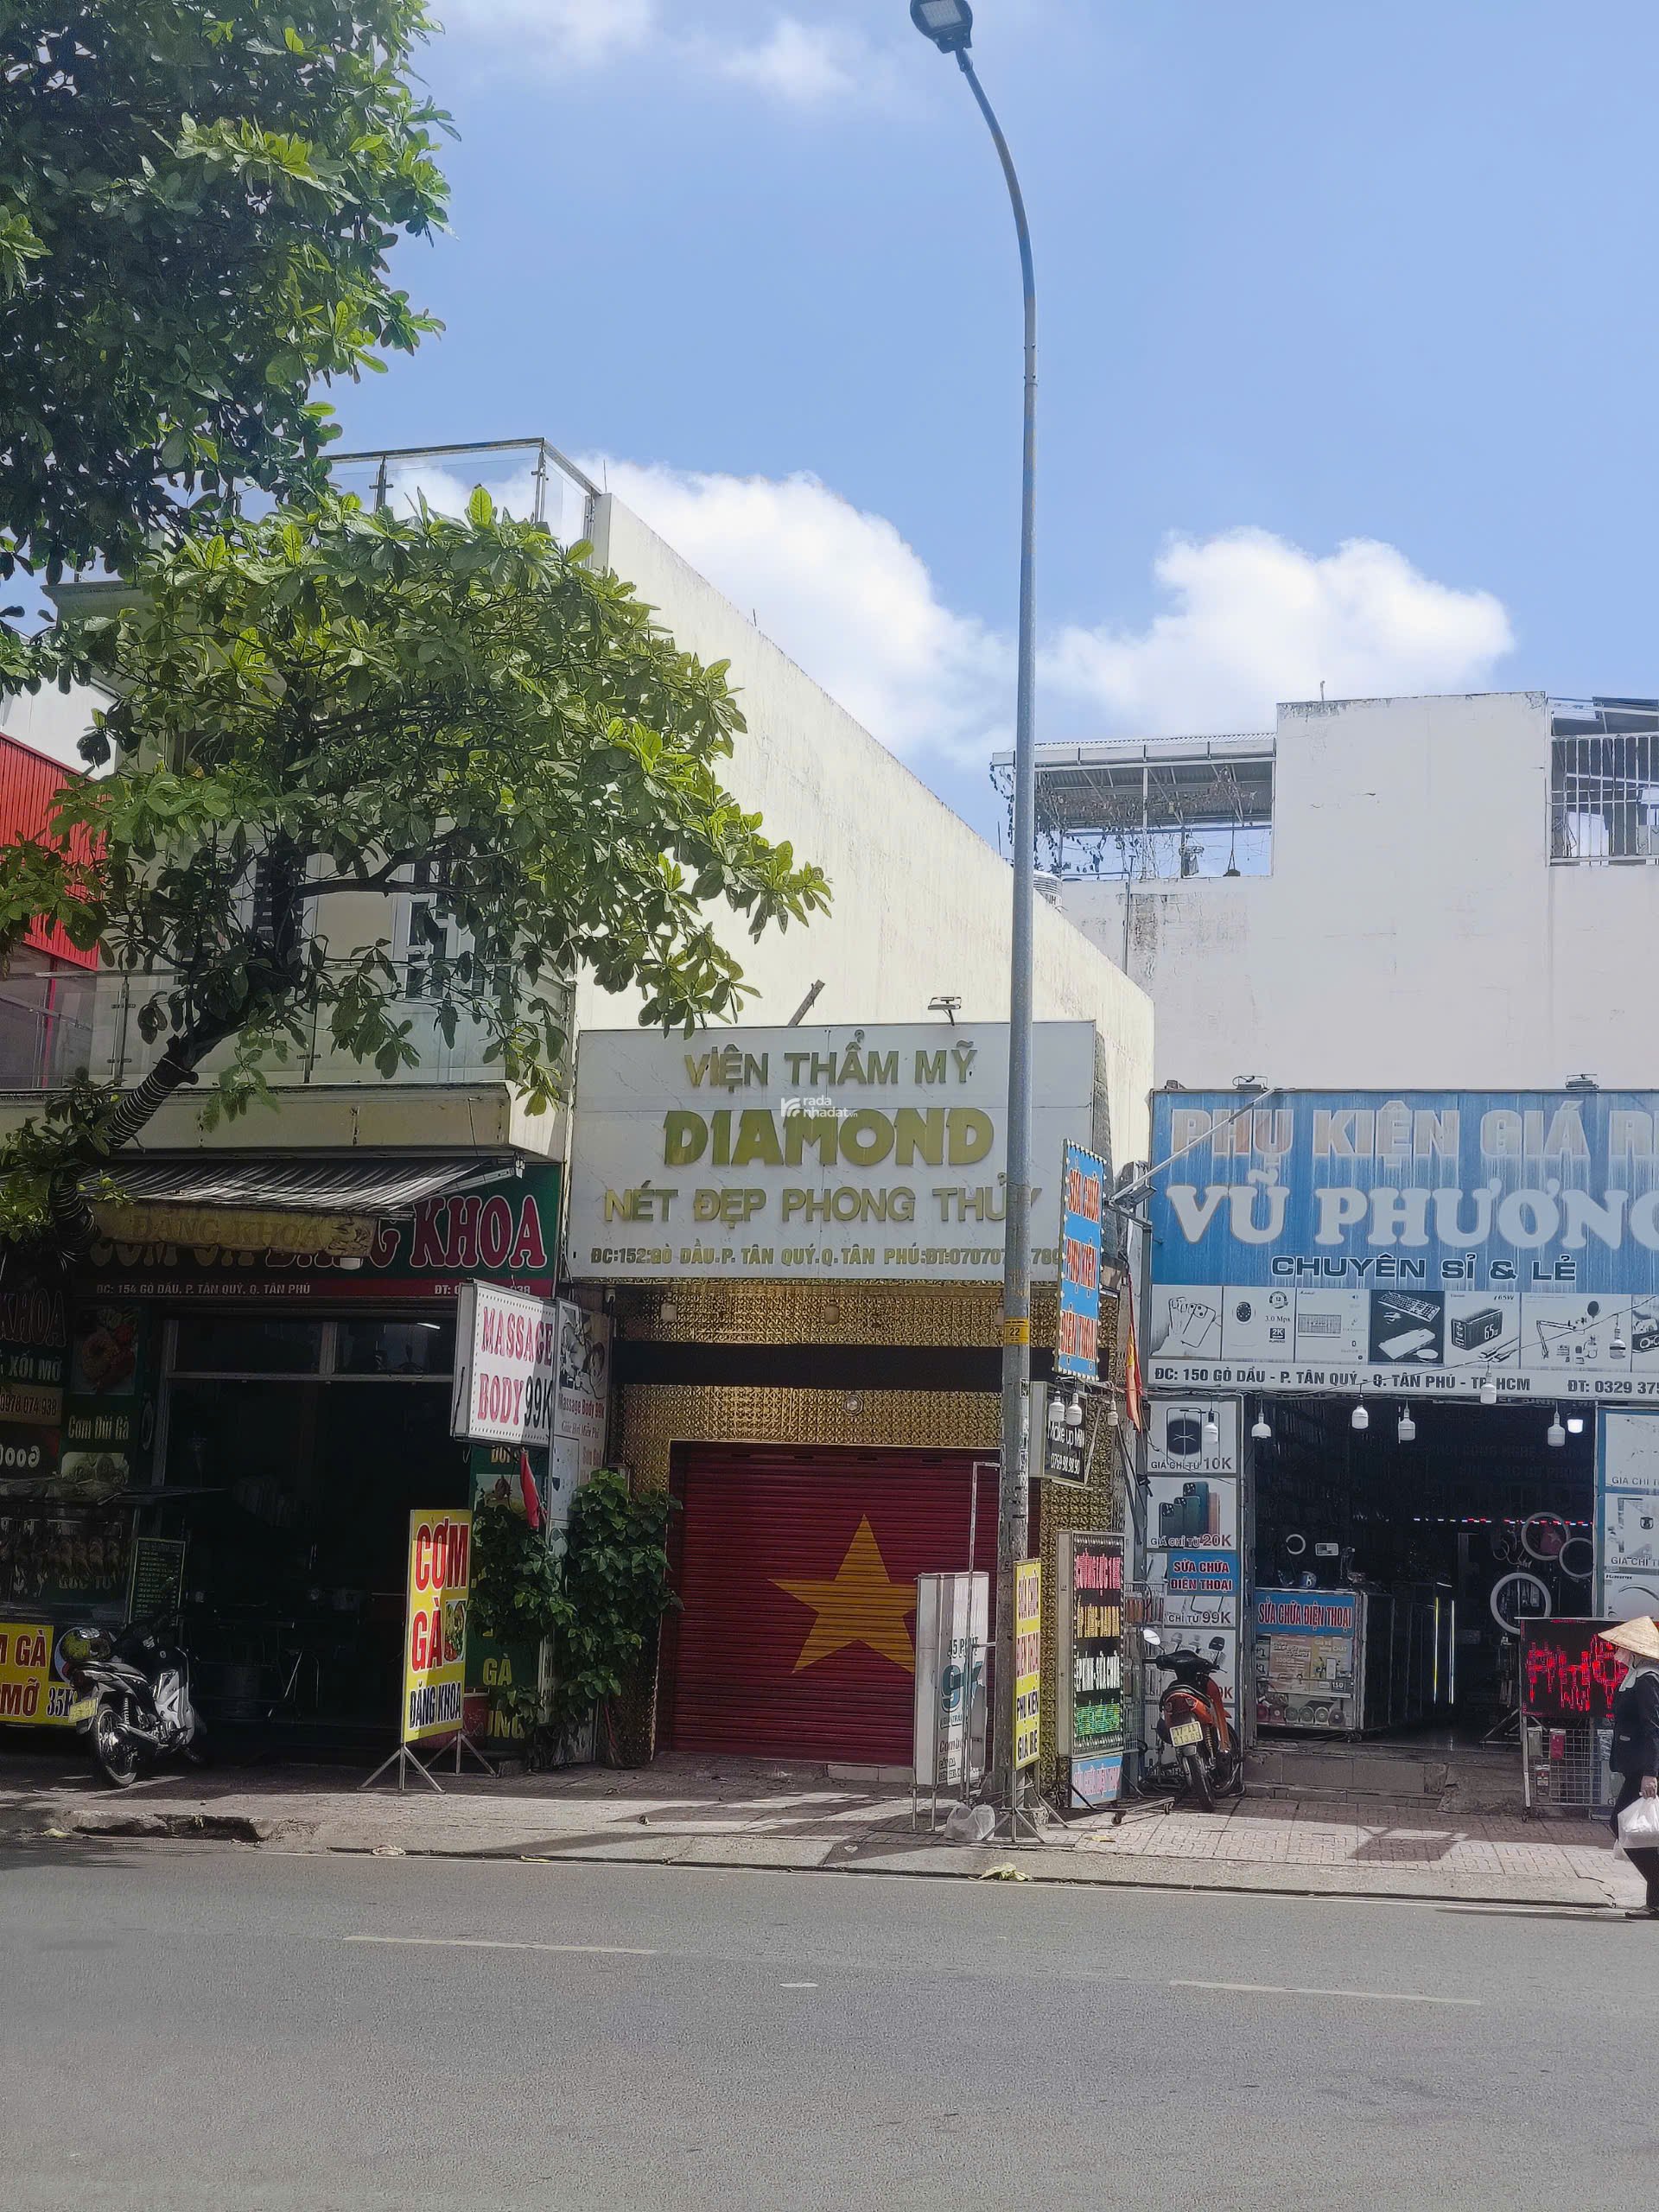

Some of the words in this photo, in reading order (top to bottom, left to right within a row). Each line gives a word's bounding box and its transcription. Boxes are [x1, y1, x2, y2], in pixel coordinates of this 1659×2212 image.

[684, 1044, 768, 1093] VIỆN
[784, 1029, 898, 1085] THẨM
[914, 1040, 977, 1084] MỸ
[664, 1108, 994, 1166] DIAMOND
[1171, 1109, 1294, 1169] PHỤ
[1313, 1100, 1459, 1168] KIỆN
[1480, 1100, 1590, 1159] GIÁ
[1609, 1109, 1659, 1158] R
[604, 1180, 679, 1222] NÉT
[693, 1188, 766, 1229] ĐẸP
[782, 1186, 916, 1222] PHONG
[932, 1172, 1042, 1222] THỦ
[1166, 1168, 1290, 1245] VŨ
[410, 1194, 547, 1269] KHOA
[741, 1244, 774, 1265] TÂN
[841, 1243, 874, 1265] TÂN
[1271, 1254, 1427, 1280] CHUYÊN
[1441, 1253, 1476, 1281] SỈ
[1490, 1260, 1517, 1281] &
[1531, 1255, 1577, 1281] LẺ
[288, 1282, 311, 1294] PHÚ
[480, 1306, 553, 1367] MASSAGE
[1154, 1368, 1178, 1380] ĐC:
[1183, 1369, 1208, 1381] 150
[1213, 1367, 1231, 1382] GÒ
[1280, 1371, 1291, 1383] P.
[1296, 1370, 1325, 1384] TÂN
[1330, 1370, 1357, 1385] QUÝ
[1372, 1374, 1387, 1387] Q.
[1392, 1372, 1421, 1388] TÂN
[1426, 1373, 1455, 1389] PHÚ
[1497, 1378, 1530, 1390] HCM
[1567, 1380, 1590, 1392] ĐT:
[1594, 1381, 1632, 1393] 0329
[1637, 1382, 1659, 1394] 37
[477, 1373, 524, 1426] BODY
[524, 1375, 553, 1430] 99K
[1204, 1458, 1231, 1470] 10K
[415, 1516, 469, 1592] CƠM
[1202, 1534, 1231, 1547] 20K
[1171, 1576, 1197, 1592] ĐIỆN
[1199, 1579, 1233, 1593] THOẠI
[1173, 1558, 1197, 1573] SỬA
[1199, 1560, 1230, 1573] CHỮA
[1202, 1611, 1231, 1624] 99K
[1258, 1596, 1276, 1624] SỬA
[1279, 1599, 1301, 1626] CHỮA
[1304, 1600, 1325, 1630] ĐIỆN
[1326, 1606, 1352, 1632] THOẠI
[15, 1629, 47, 1668] GÀ
[410, 1597, 443, 1673] GÀ
[483, 1653, 512, 1687] GÀ
[0, 1677, 41, 1717] MỠ
[47, 1687, 76, 1717] 35K
[409, 1681, 436, 1728] ĐĂNG
[437, 1681, 462, 1722] KHOA
